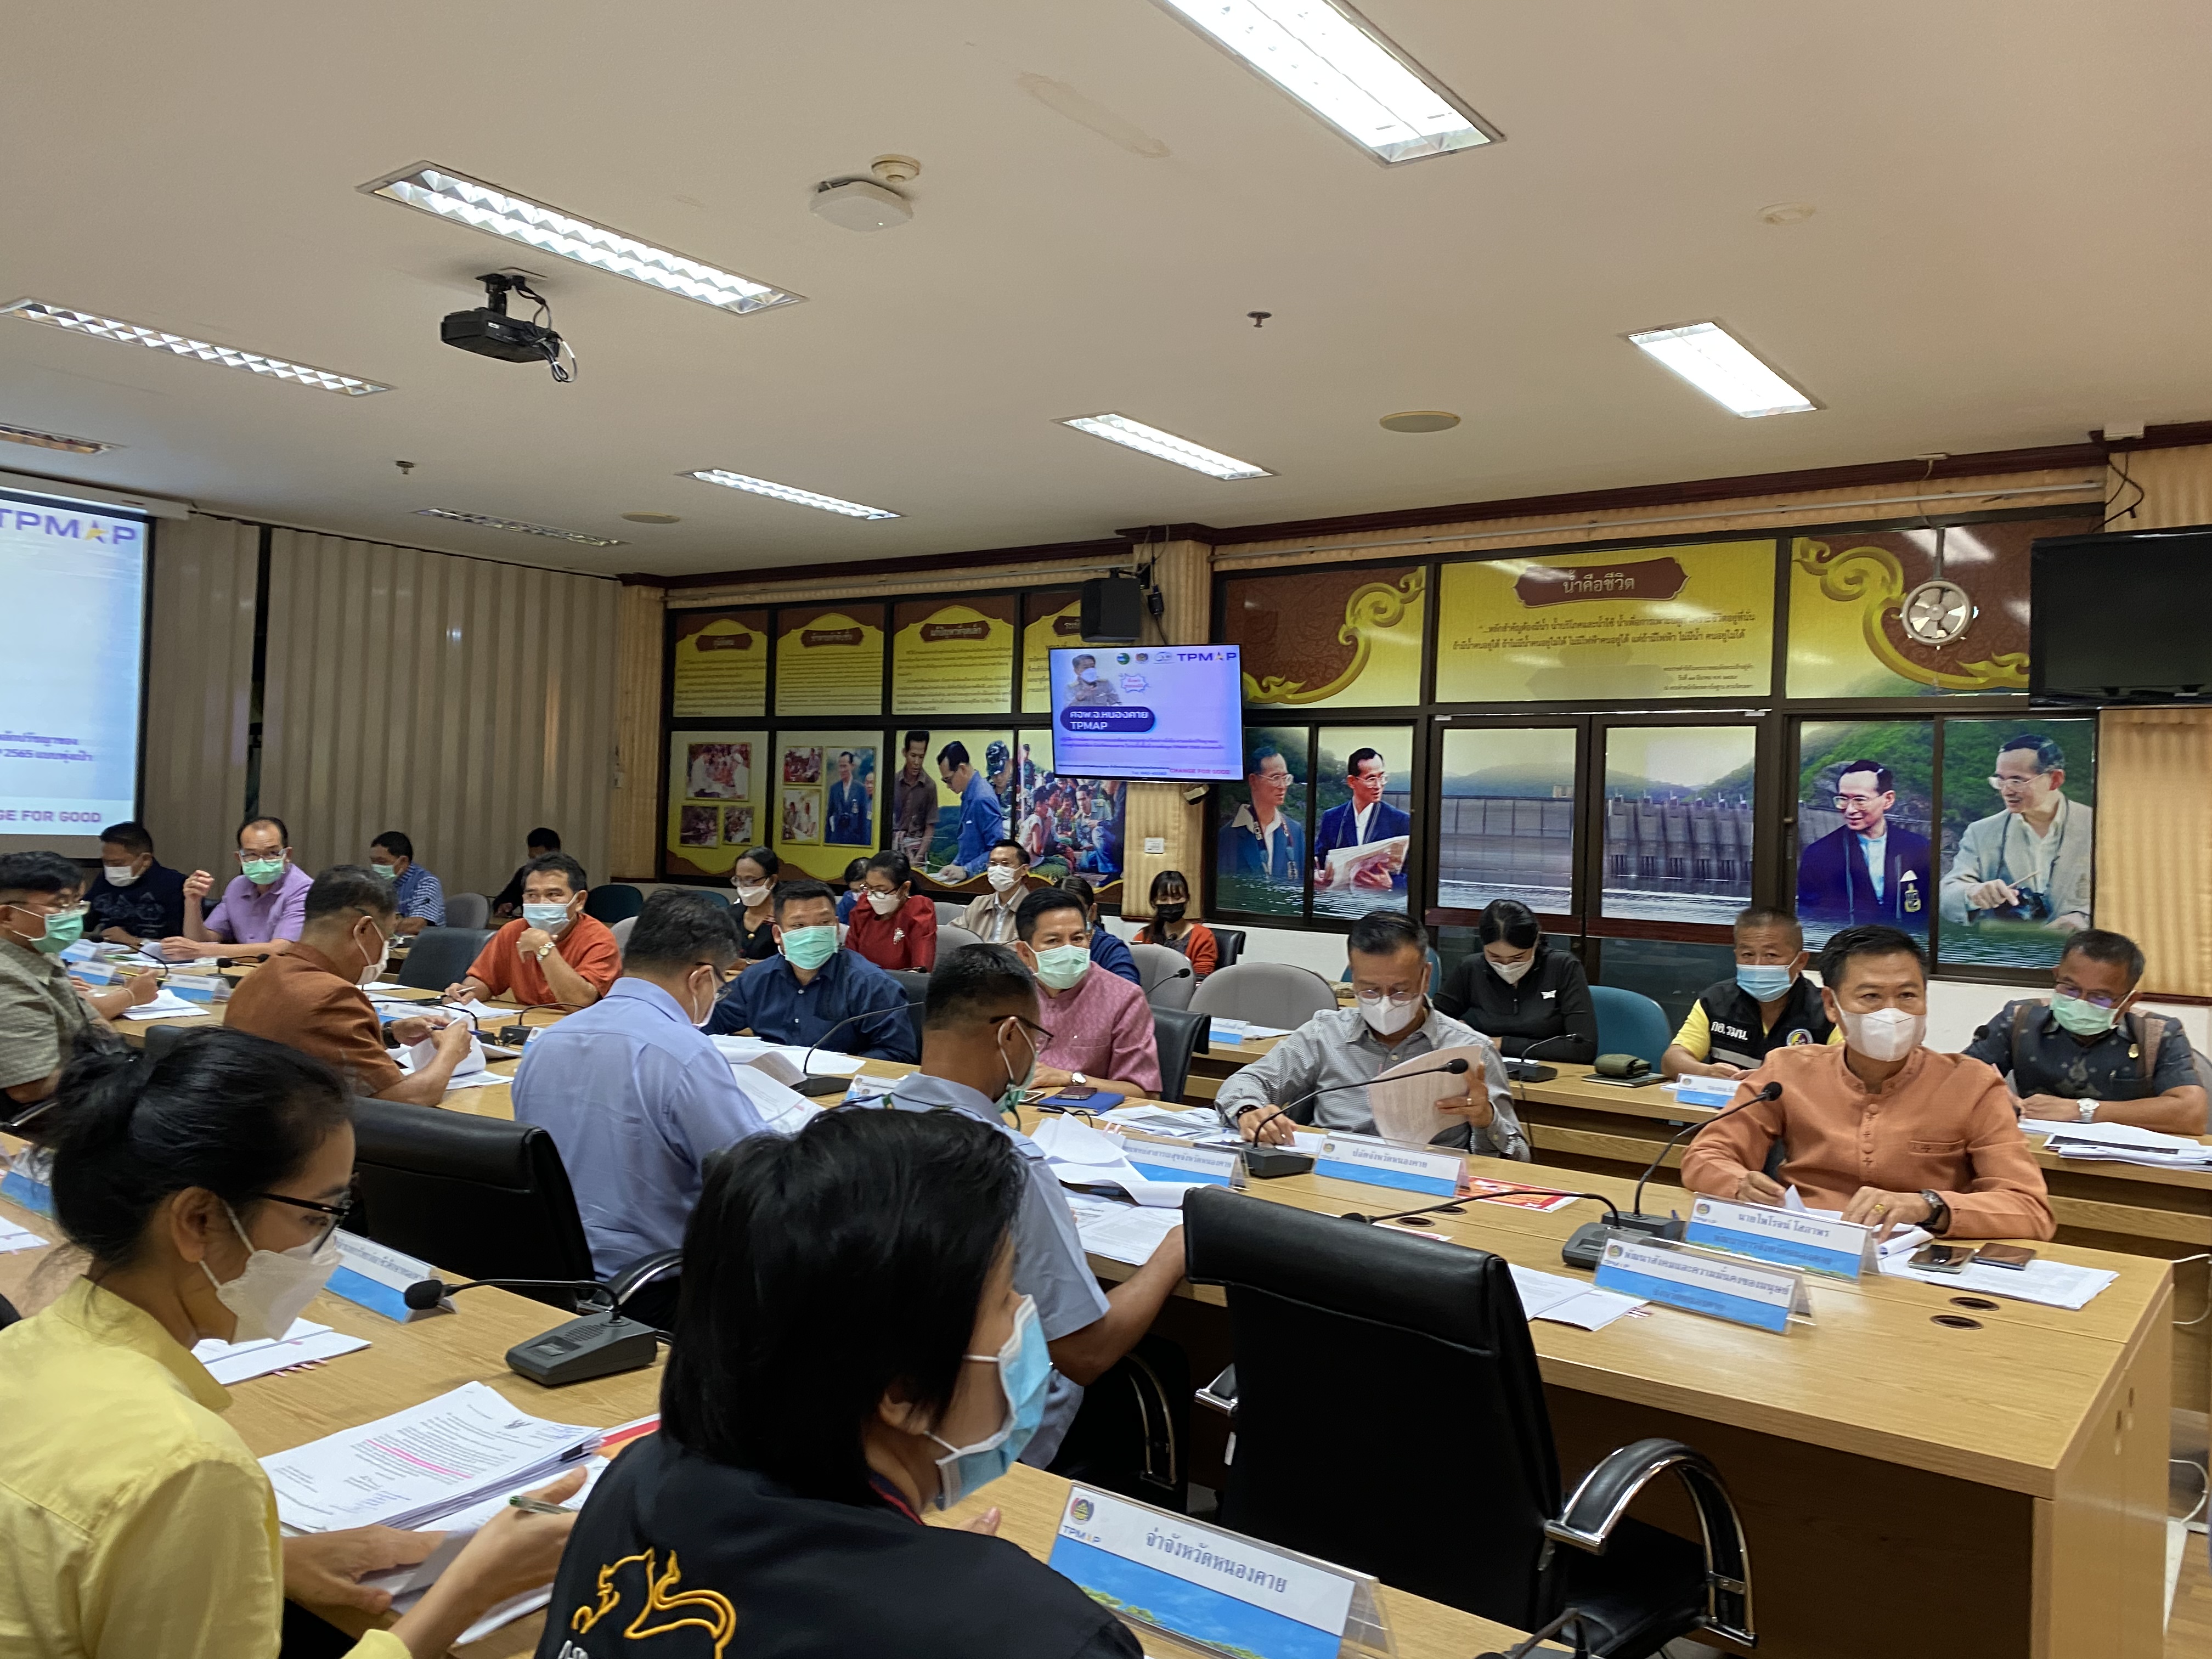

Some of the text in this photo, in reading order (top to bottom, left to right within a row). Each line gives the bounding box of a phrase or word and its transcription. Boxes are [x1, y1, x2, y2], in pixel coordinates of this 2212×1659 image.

[1562, 569, 1635, 593] น้ำคือชีวิต
[1070, 721, 1108, 730] TPMAP
[21, 810, 54, 822] FOR
[59, 811, 101, 823] GOOD
[1352, 1148, 1428, 1168] ปลัดจังหวัดหนองคาย
[1623, 1249, 1792, 1295] พัฒนาสังคมและความมั่นคงของมนุษย์
[1146, 1527, 1288, 1593] จ่าจังหวัดหนองคาย
